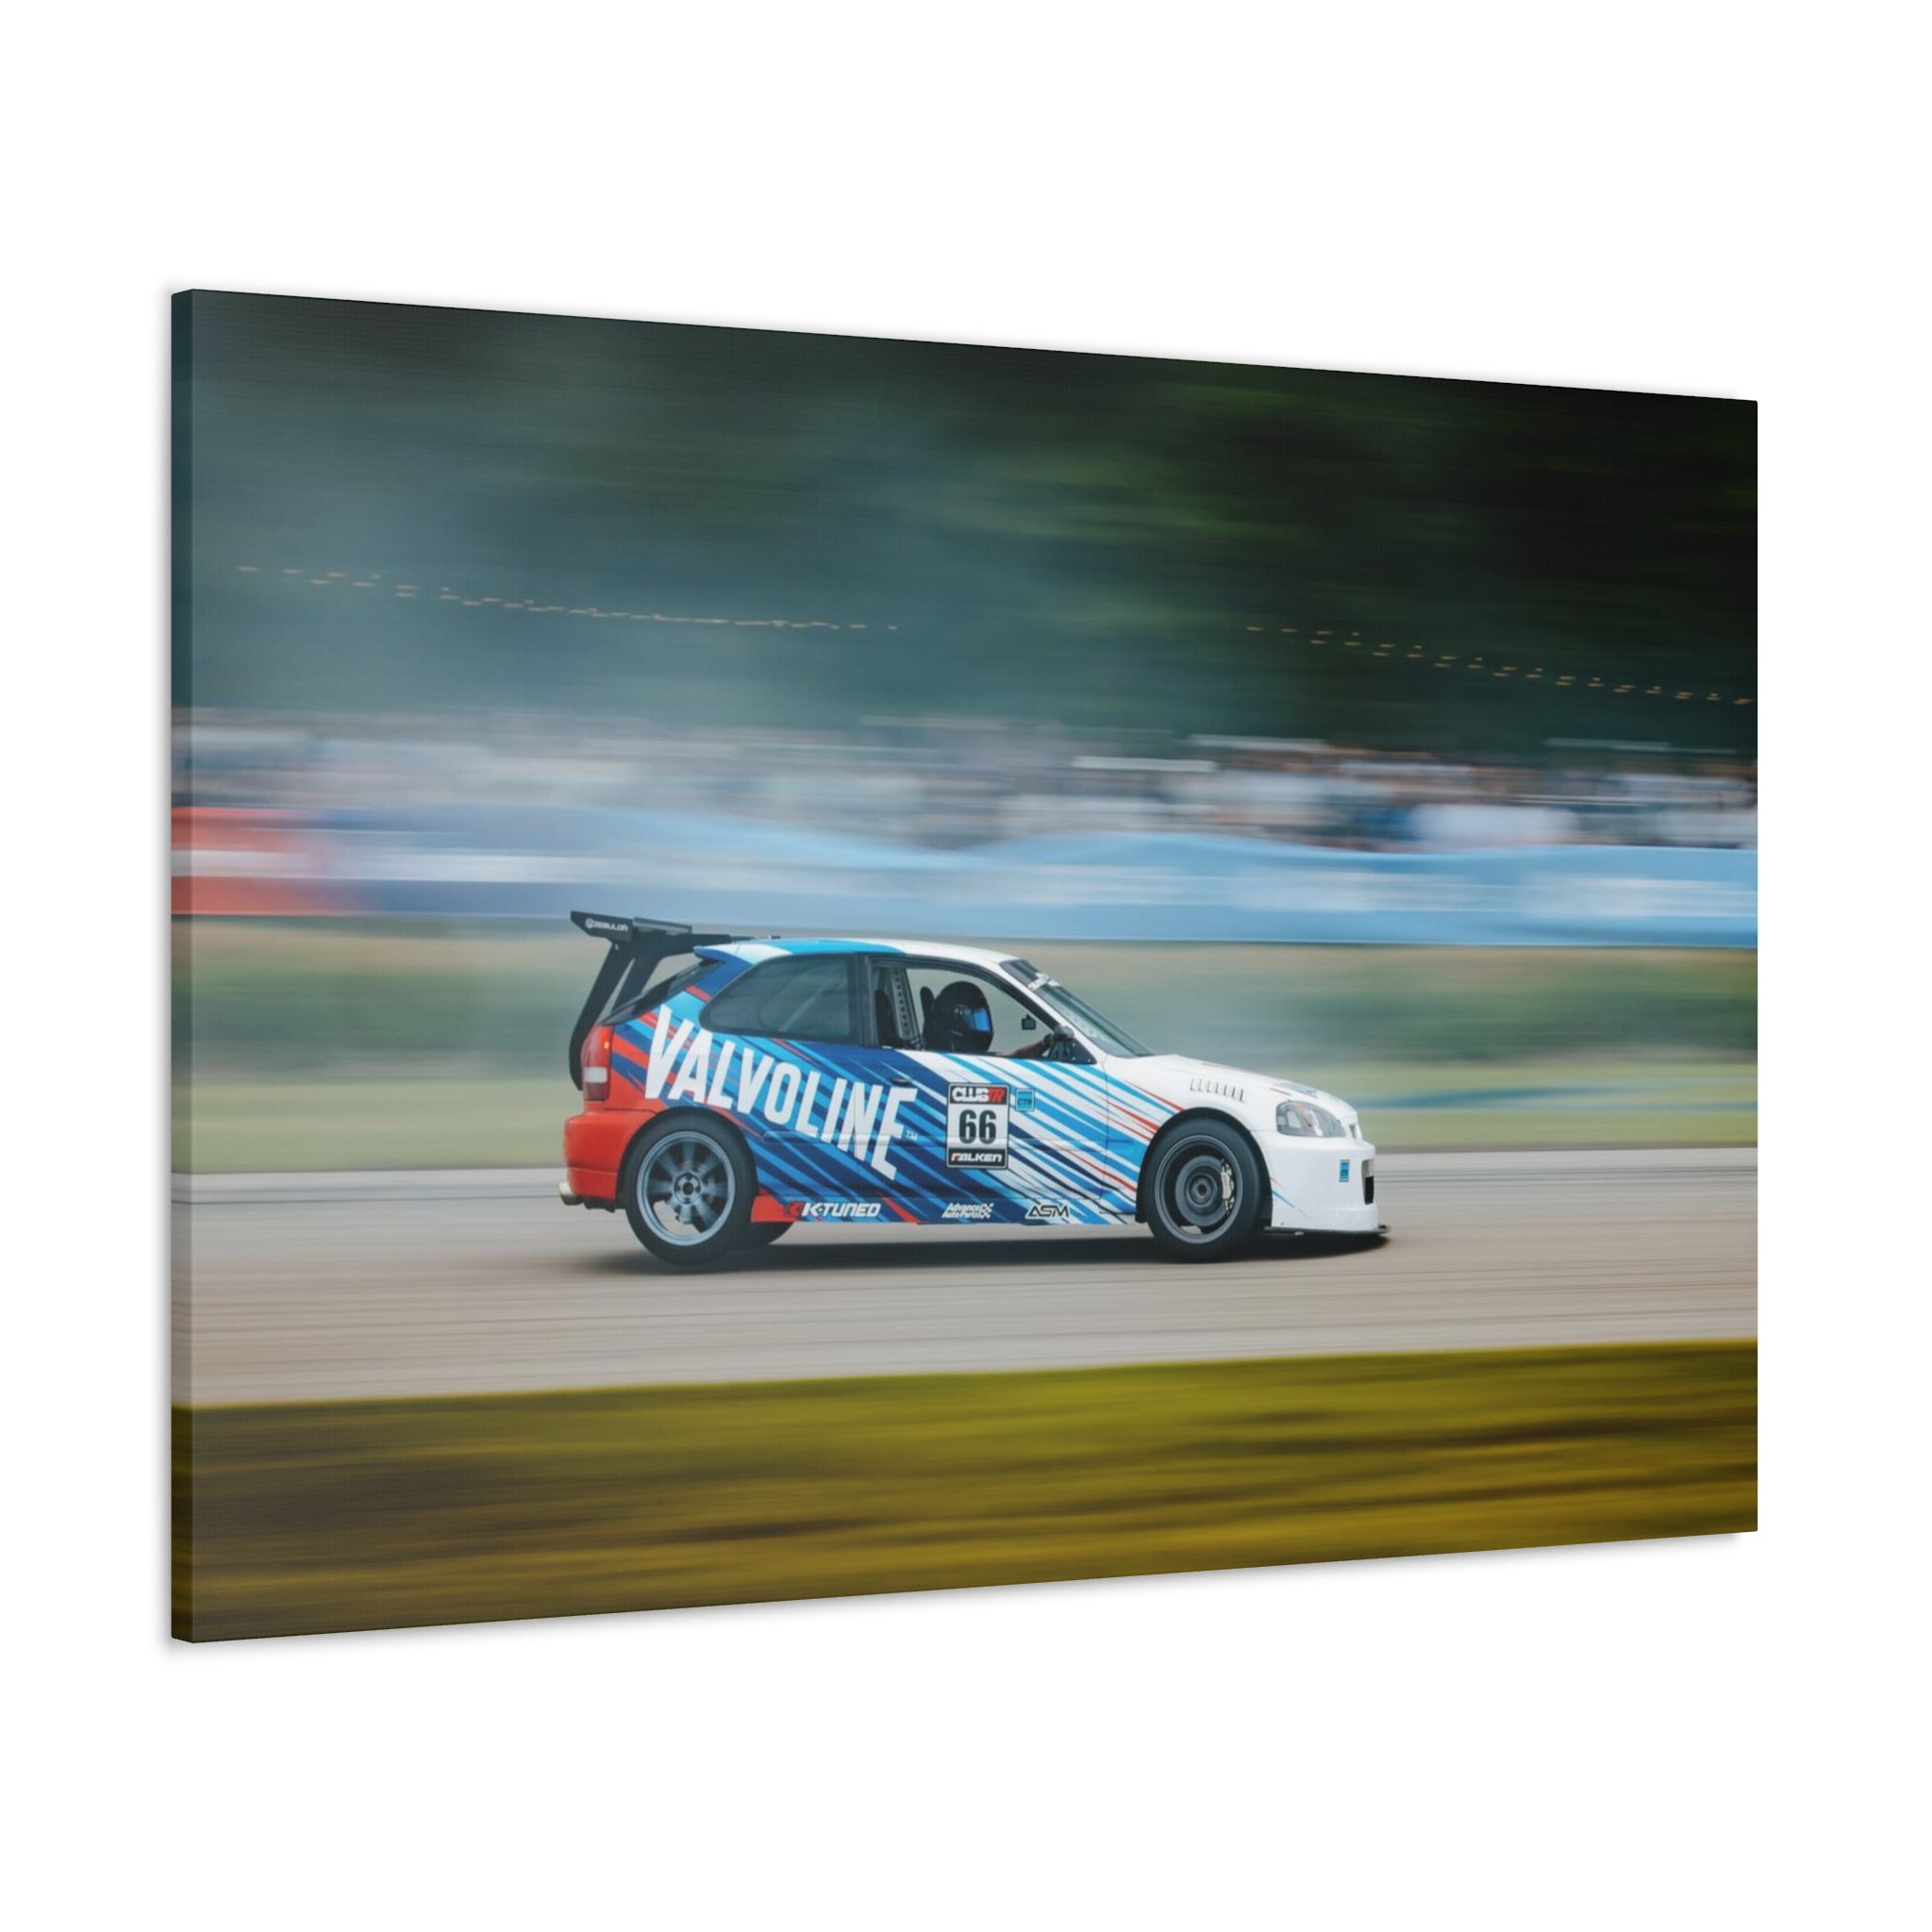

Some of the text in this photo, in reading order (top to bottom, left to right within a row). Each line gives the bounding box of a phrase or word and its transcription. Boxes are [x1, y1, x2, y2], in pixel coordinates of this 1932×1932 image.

[644, 1003, 918, 1181] VALVOLINE
[958, 1108, 997, 1144] 66
[951, 1152, 1003, 1163] FALKEN
[801, 1202, 882, 1218] K-TUNED
[1025, 1204, 1070, 1218] ASM
